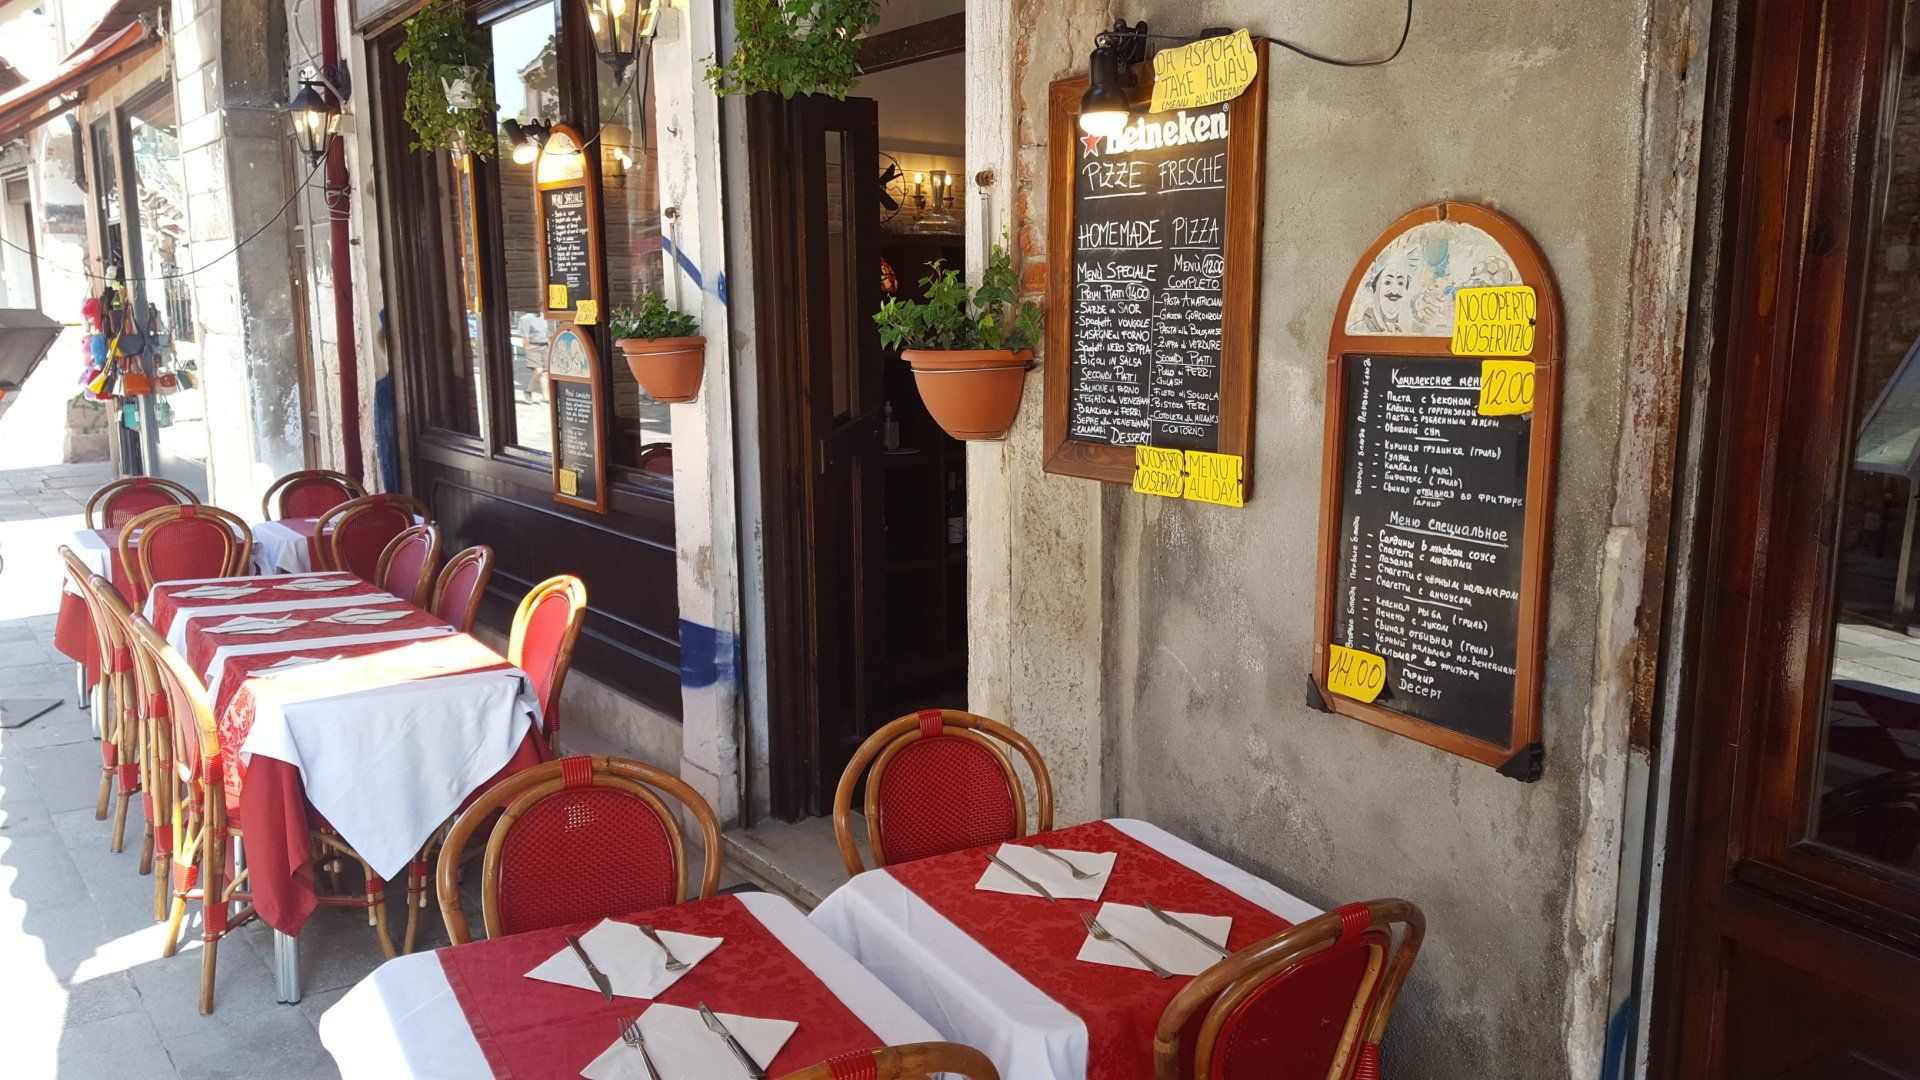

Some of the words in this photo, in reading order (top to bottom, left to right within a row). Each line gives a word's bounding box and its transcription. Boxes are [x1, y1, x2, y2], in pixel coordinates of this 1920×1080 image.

[1154, 52, 1175, 76] DA
[1183, 29, 1253, 69] ASPORTO
[1162, 71, 1195, 99] TAKE
[1206, 56, 1249, 88] AWAY
[1105, 111, 1228, 154] Heineken
[1083, 160, 1144, 191] PIZZE
[1158, 153, 1225, 191] FRESCHE
[1078, 218, 1162, 248] HOMEMADE
[1172, 216, 1219, 246] PIZZA
[1107, 261, 1158, 282] SPECIALE
[1167, 275, 1219, 289] COMPLETO
[1080, 302, 1107, 315] SARDE
[1118, 301, 1142, 314] SAOR
[1118, 319, 1151, 330] VONGOLE
[1121, 330, 1150, 342] FORNO
[1188, 339, 1222, 350] VERDURE
[1120, 355, 1142, 367] SALSA
[1459, 376, 1482, 387] мен
[1482, 368, 1535, 406] 12.00
[1387, 390, 1412, 403] Паста
[1386, 412, 1411, 422] Паста
[1110, 427, 1151, 444] DESSERT
[1384, 440, 1419, 453] Куриная
[1189, 477, 1209, 499] ALL
[1211, 479, 1235, 503] DAY
[1389, 510, 1421, 528] Меню
[1378, 542, 1414, 559] Спагетти
[1379, 529, 1415, 549] Сардины
[1468, 550, 1497, 564] соусе
[1378, 563, 1414, 580] Спагетти
[1376, 575, 1411, 593] Спагетти
[1375, 643, 1417, 662] Кальмар
[1330, 650, 1382, 688] 14.00
[1402, 668, 1435, 685] Гарнир
